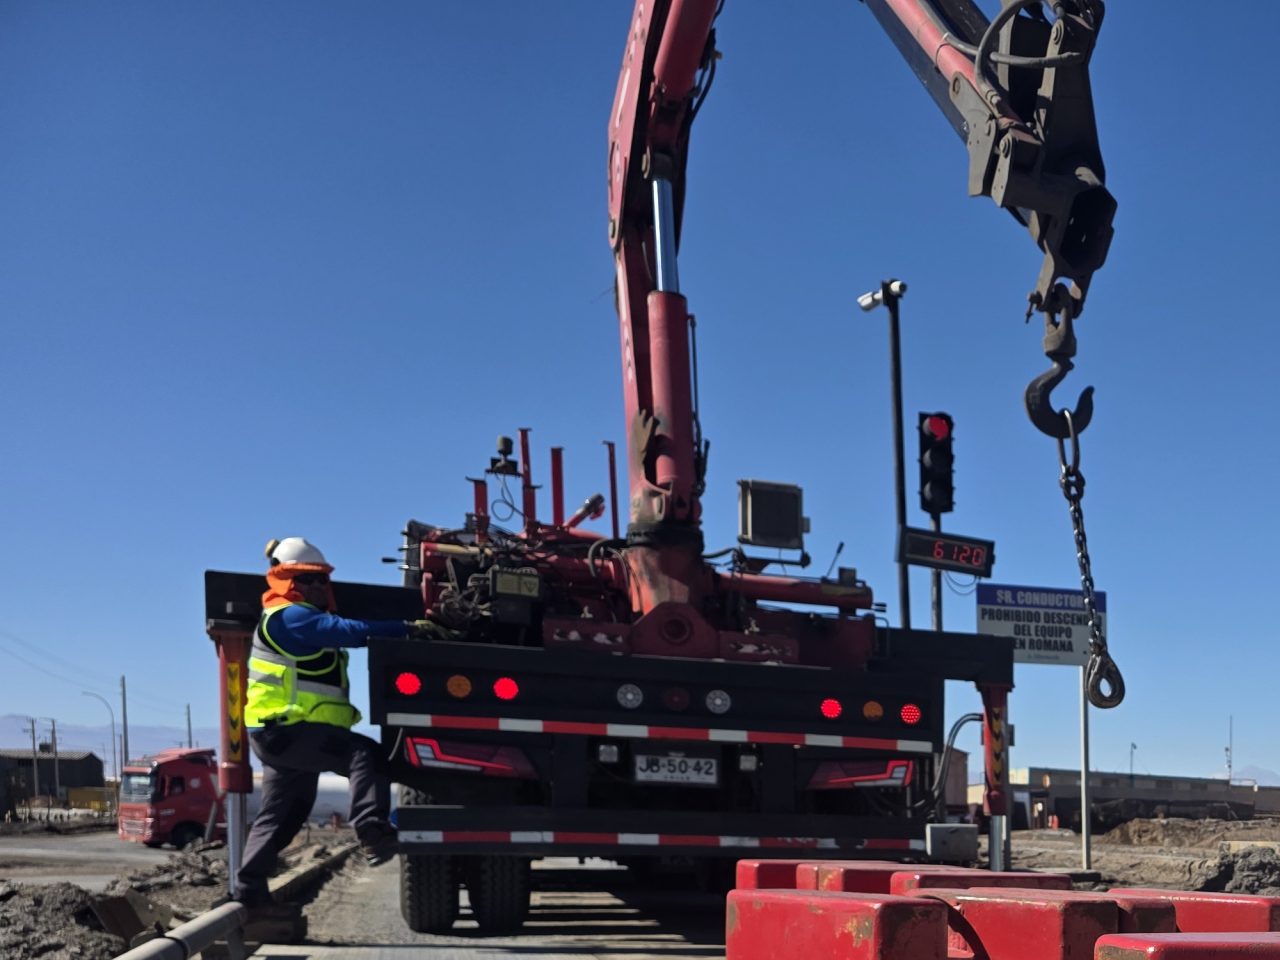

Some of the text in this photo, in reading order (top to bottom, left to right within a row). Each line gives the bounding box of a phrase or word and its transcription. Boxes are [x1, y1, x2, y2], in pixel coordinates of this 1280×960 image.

[1017, 590, 1085, 609] CONDUCTOR
[981, 608, 1041, 623] PROHIBIDO
[1014, 624, 1073, 639] DEL EQUIPO
[1028, 639, 1074, 653] ROMANA
